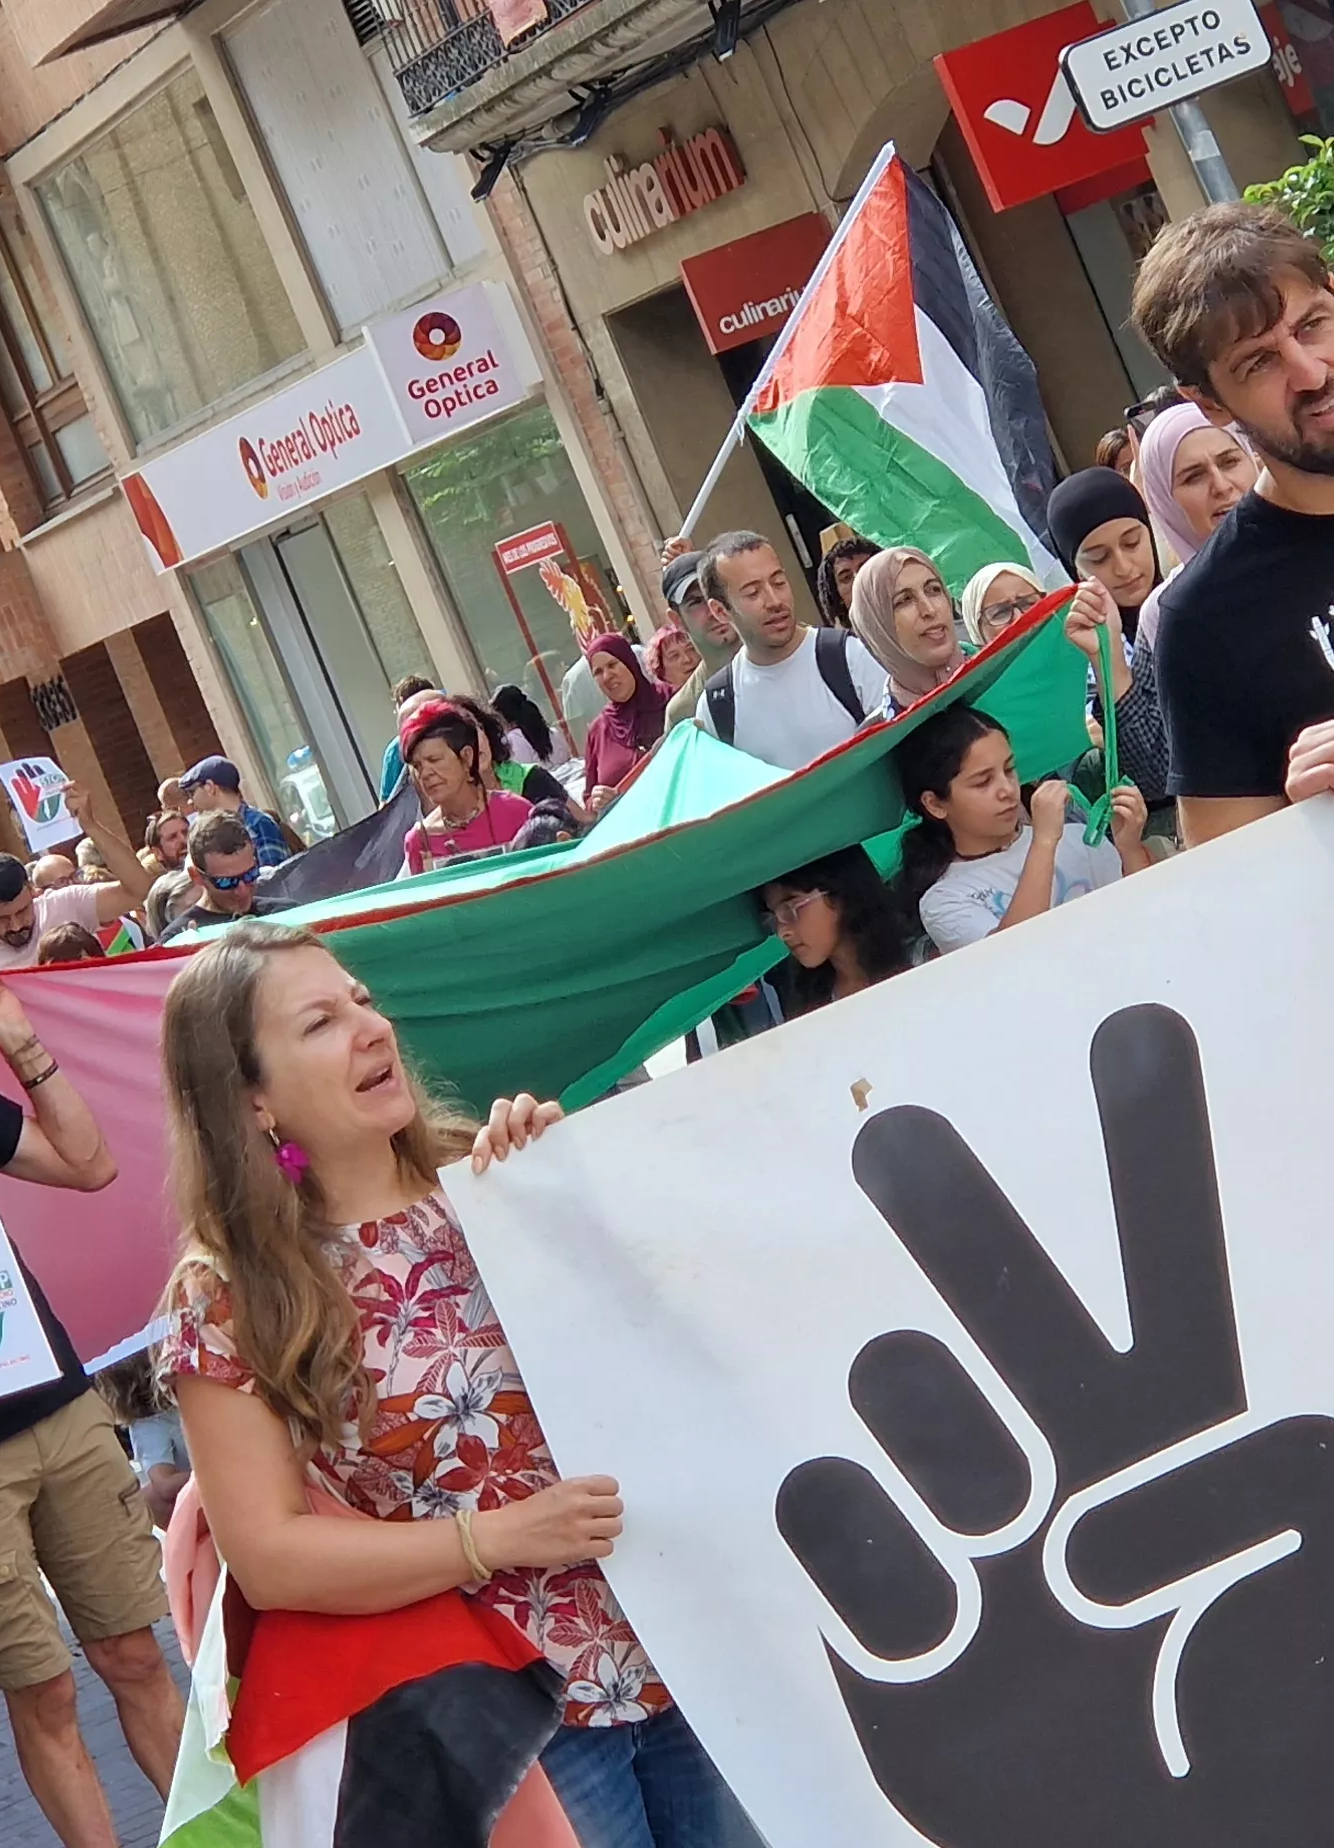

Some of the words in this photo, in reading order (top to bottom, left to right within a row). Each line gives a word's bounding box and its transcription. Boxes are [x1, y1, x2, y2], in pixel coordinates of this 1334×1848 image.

[1100, 34, 1251, 110] BICICLETAS
[1102, 10, 1221, 72] EXCEPTO
[583, 126, 743, 256] culinarium
[719, 286, 805, 335] culinari
[408, 349, 500, 400] General
[424, 379, 500, 419] Optica
[258, 416, 318, 478] General
[308, 398, 361, 460] Optica
